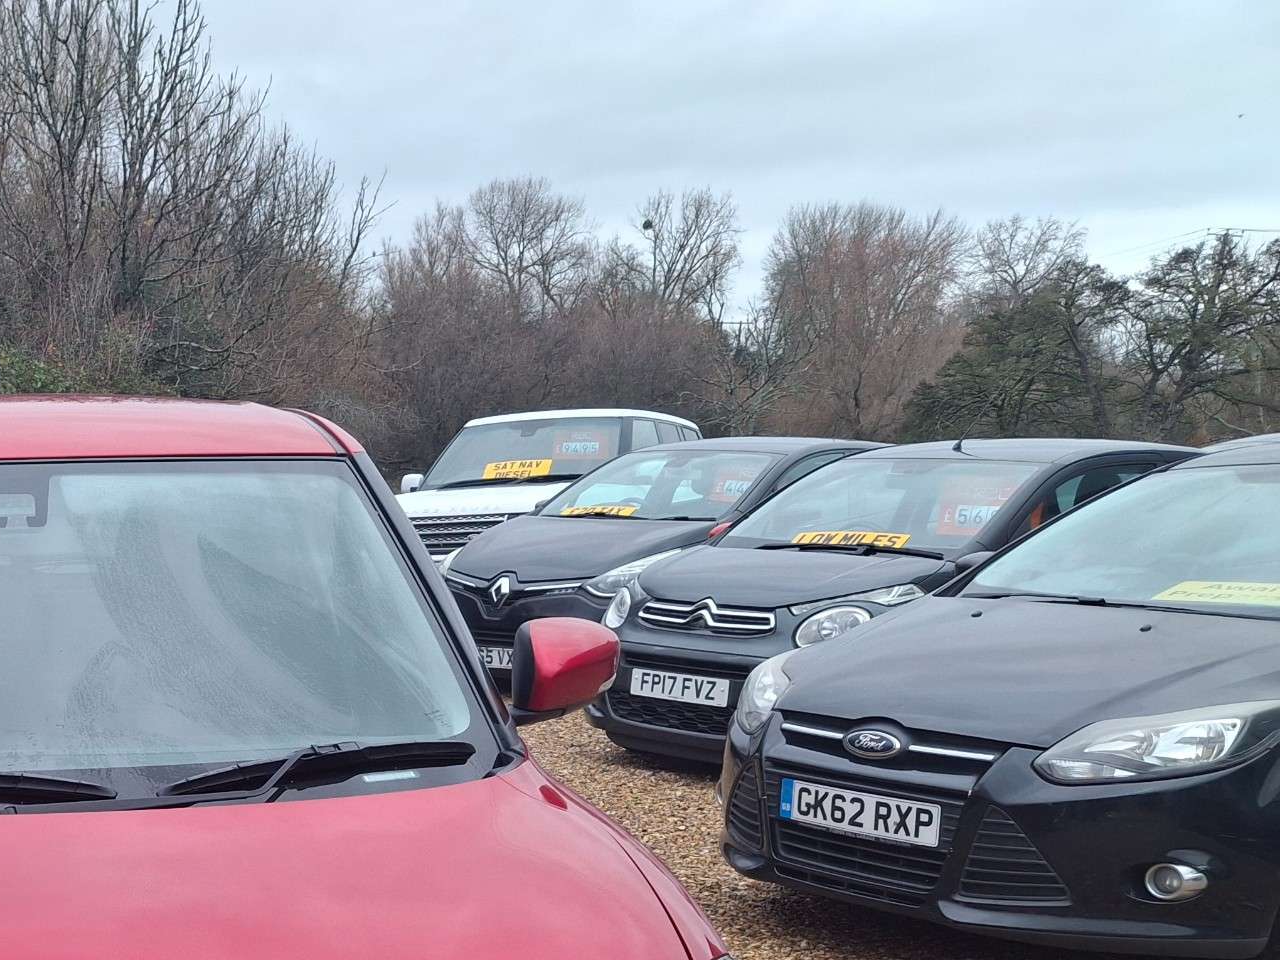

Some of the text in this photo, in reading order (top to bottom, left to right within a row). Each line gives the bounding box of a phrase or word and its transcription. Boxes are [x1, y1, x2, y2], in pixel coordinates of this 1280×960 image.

[493, 460, 543, 471] SAT NAV
[797, 533, 901, 547] LOW MILES
[640, 672, 717, 701] FP17 FVZ
[855, 733, 887, 752] Ford
[797, 786, 865, 828] GK62
[873, 801, 934, 838] RXP
